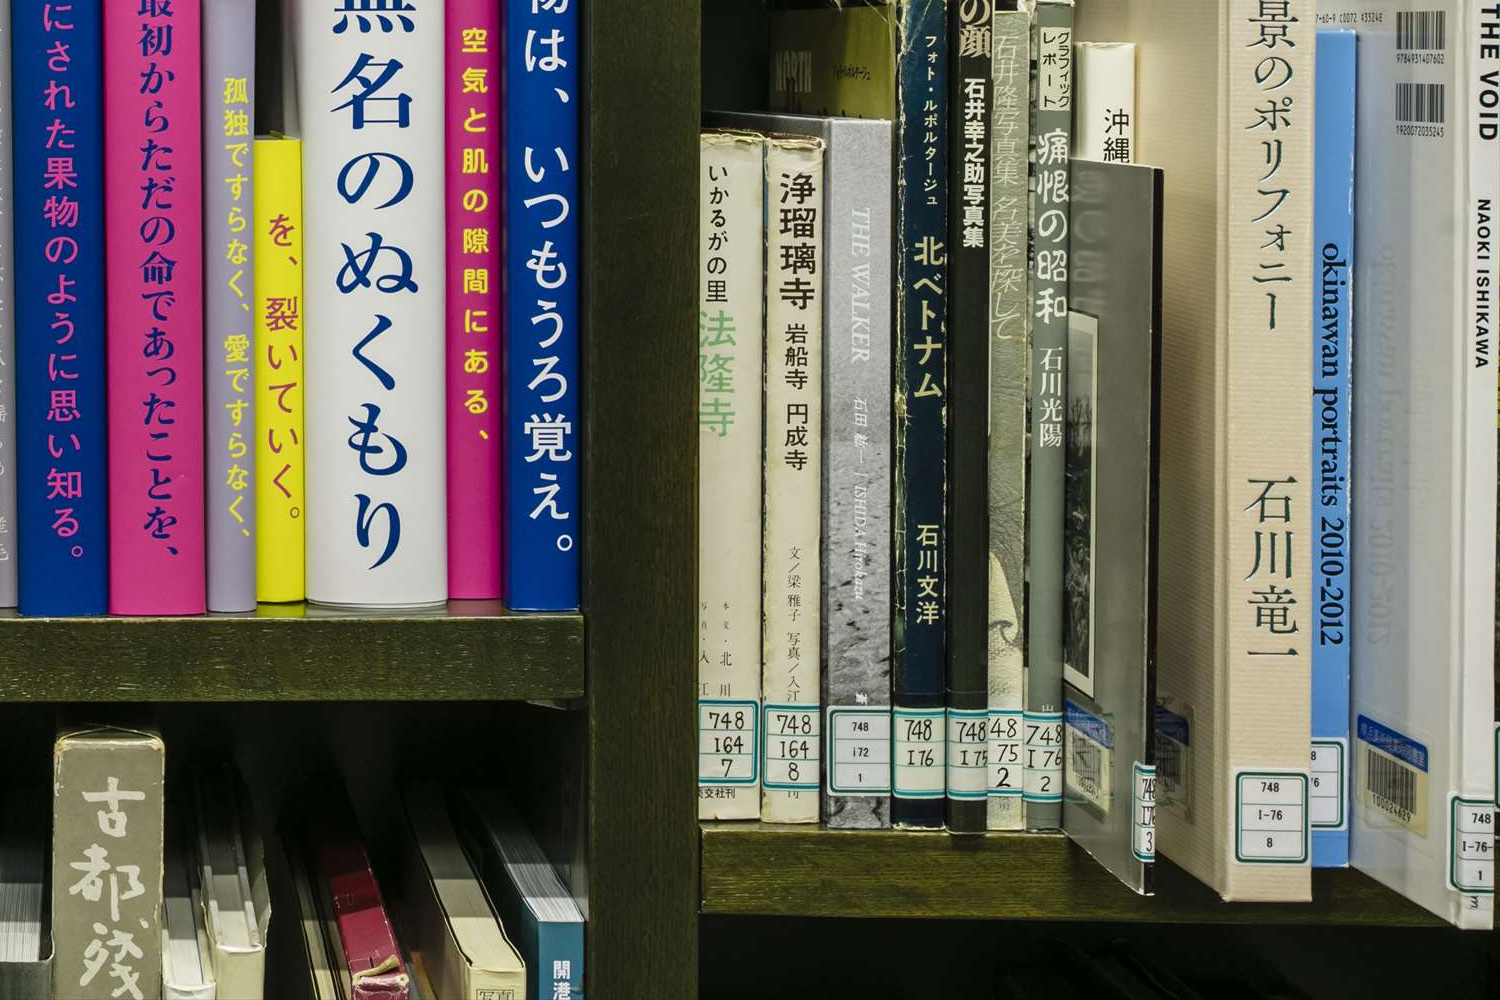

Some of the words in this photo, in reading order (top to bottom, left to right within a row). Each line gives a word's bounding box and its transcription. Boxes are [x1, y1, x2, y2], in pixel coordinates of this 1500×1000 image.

[1480, 3, 1500, 61] THE
[963, 79, 985, 248] 石井幸之助写真集
[1478, 70, 1499, 142] VOID
[461, 27, 489, 440] 空気と肌の隙間にある、
[706, 165, 729, 303] いかるがの里
[779, 173, 816, 310] 浄瑠璃寺
[1036, 127, 1069, 324] 痛恨の昭和
[1474, 199, 1491, 260] NAOKI
[913, 236, 945, 399] 北ベトナム
[1321, 243, 1347, 378] okinawan
[1472, 268, 1491, 369] ISHIKAWA
[1038, 347, 1062, 448] 石川光陽
[1313, 386, 1341, 507] portraits
[916, 524, 940, 624] 石川文洋
[1244, 476, 1299, 657] 石川竜一
[1319, 516, 1344, 646] 2010-2012
[851, 722, 869, 732] 748
